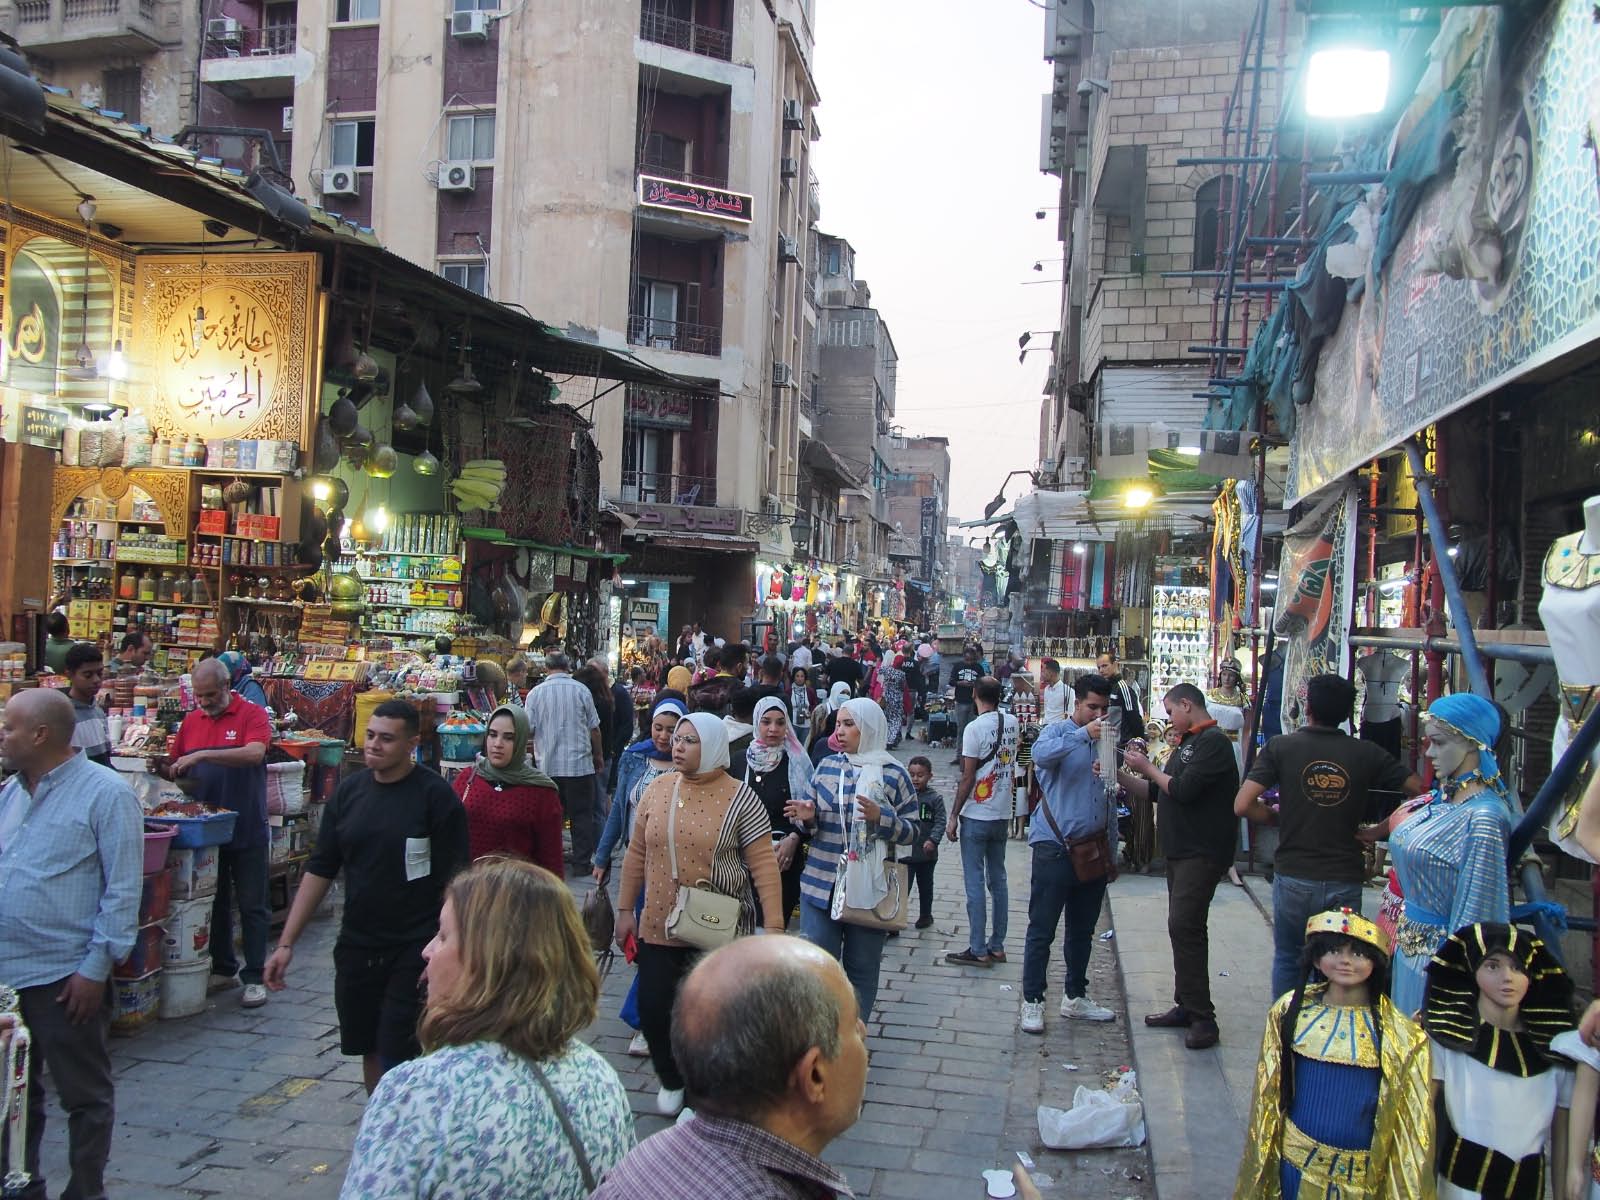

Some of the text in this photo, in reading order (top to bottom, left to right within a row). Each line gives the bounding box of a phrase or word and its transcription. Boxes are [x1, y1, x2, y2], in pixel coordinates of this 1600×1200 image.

[649, 182, 743, 212] فندق رضوان
[178, 364, 262, 420] الحرمين
[634, 602, 657, 613] ATM
